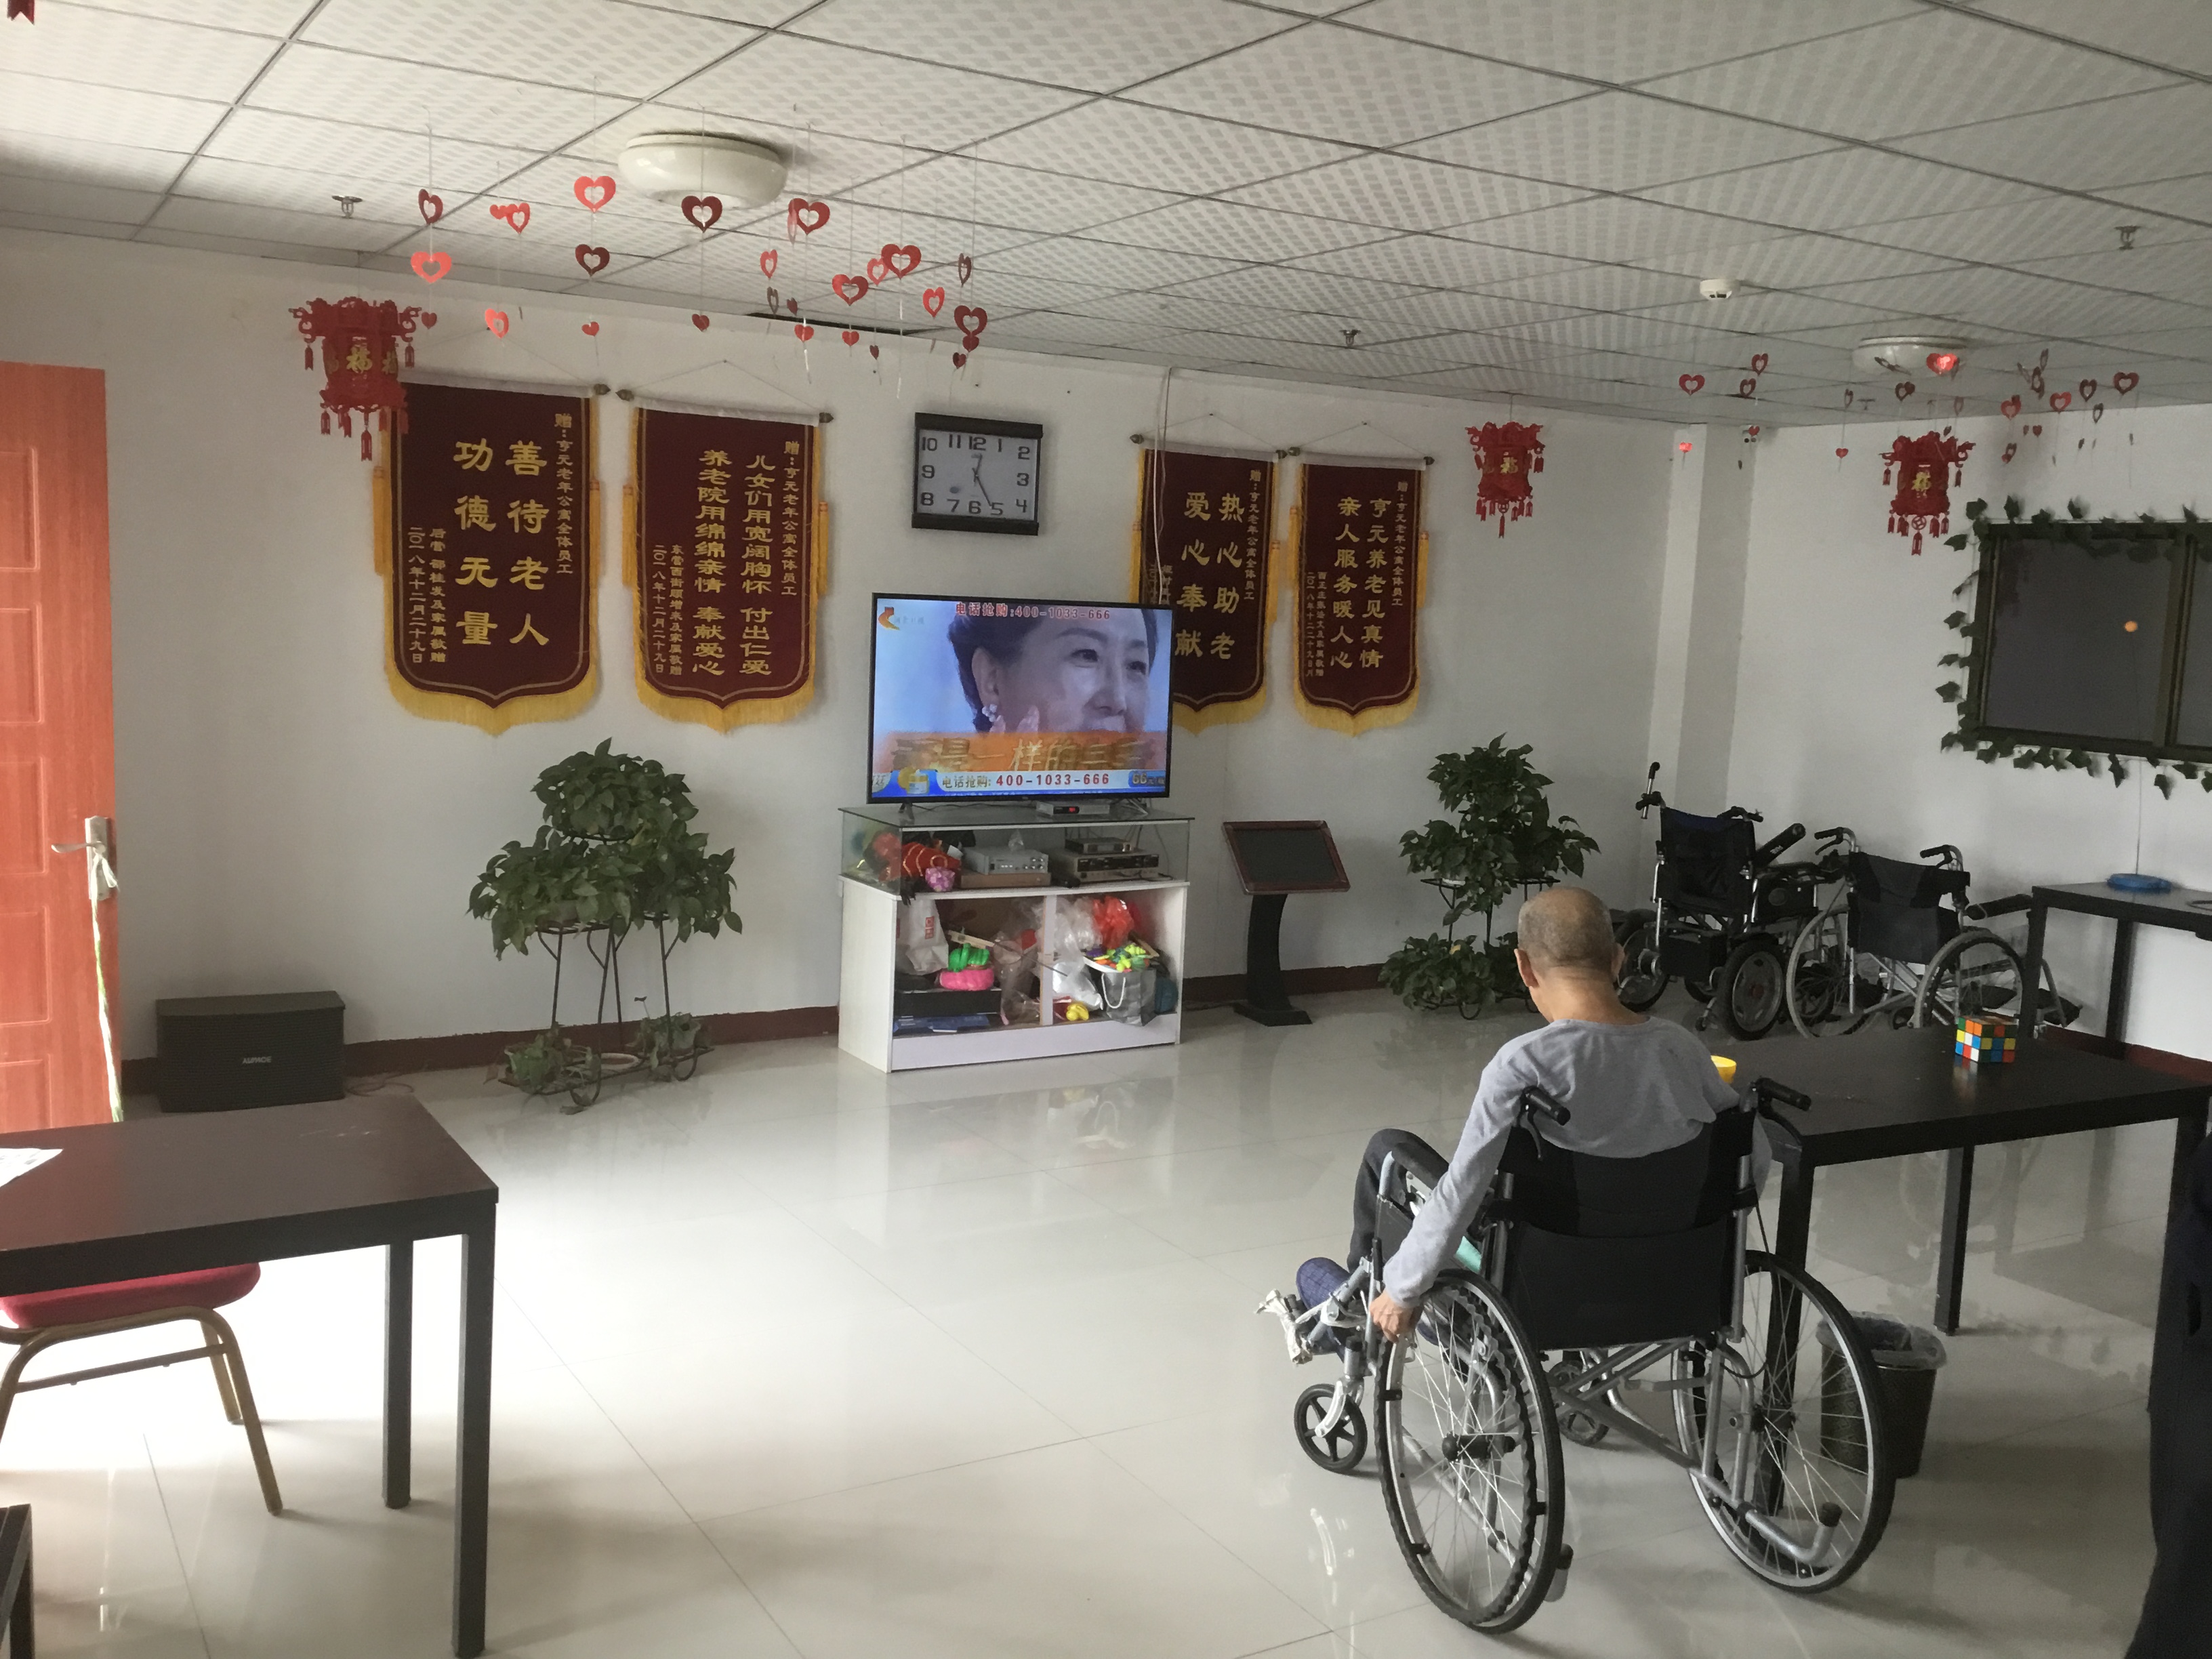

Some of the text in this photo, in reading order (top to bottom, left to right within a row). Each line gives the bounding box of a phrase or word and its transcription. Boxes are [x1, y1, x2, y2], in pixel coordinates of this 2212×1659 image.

[920, 492, 1027, 516] 8 7 6 5 4
[921, 434, 1030, 460] 10 11 12 1 2
[921, 464, 935, 478] 9
[1017, 472, 1029, 487] 3
[453, 438, 498, 646] 功德无量
[506, 441, 550, 647] 善待老人
[1174, 491, 1211, 658] 爱心奉献
[1210, 493, 1245, 660] 热心助老
[1330, 497, 1361, 669] 亲人服务暖人心
[1359, 497, 1391, 668] 亨元养老见真情
[996, 773, 1109, 786] 400-1033-666
